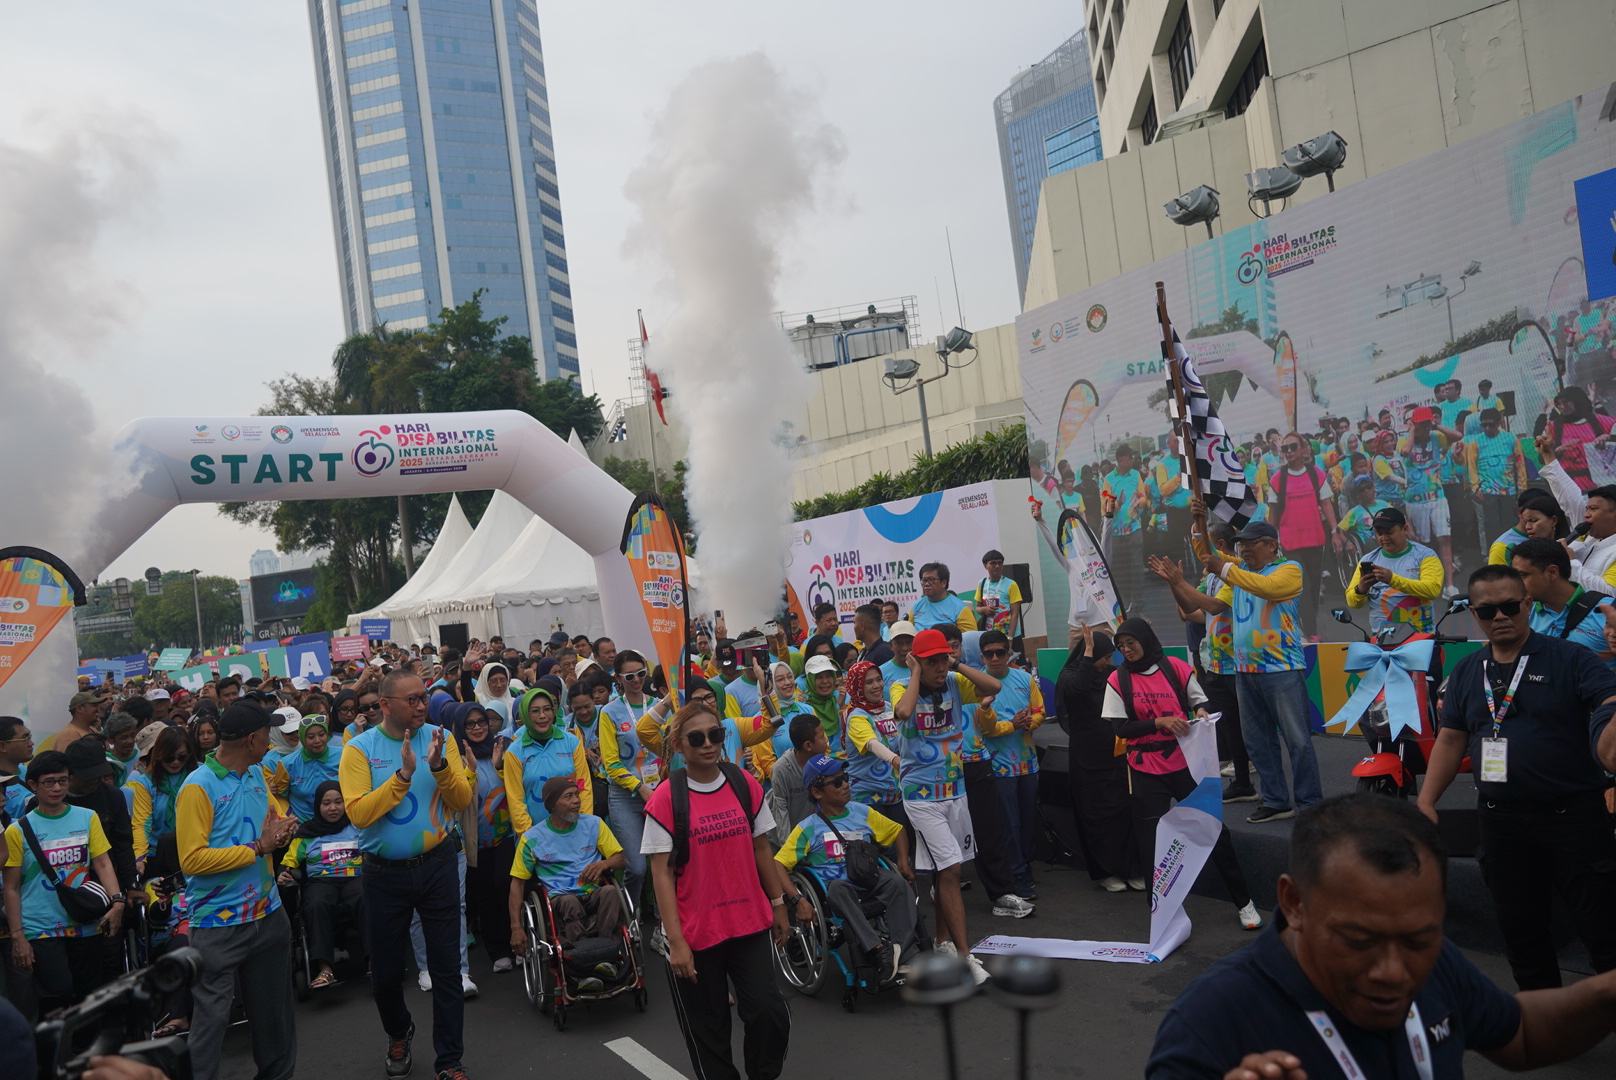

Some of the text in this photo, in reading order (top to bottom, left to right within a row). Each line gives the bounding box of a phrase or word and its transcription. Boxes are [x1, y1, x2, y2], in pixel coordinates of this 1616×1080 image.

[1263, 233, 1287, 250] HARI
[1264, 226, 1336, 258] DISABILITAS
[1265, 237, 1337, 266] INTERNASIONAL
[1126, 360, 1165, 376] STAR
[394, 423, 430, 434] HARI
[396, 429, 496, 446] DISABILITAS
[398, 442, 498, 458] INTERNASIONAL
[190, 453, 344, 485] START
[400, 458, 423, 467] 2025
[834, 550, 860, 568] HARI
[836, 559, 914, 586] DISABILITAS
[838, 581, 917, 600] INTERNASIONAL
[839, 601, 856, 612] 2025
[259, 628, 286, 639] GRA
[300, 652, 323, 677] A
[698, 809, 737, 824] STREET
[688, 816, 747, 838] MANAGEMEN
[698, 826, 748, 846] MANAGER
[964, 834, 972, 850] 9
[48, 848, 81, 866] 0885
[1154, 844, 1185, 892] INTERNASIONAL
[1430, 1017, 1449, 1042] YNT
